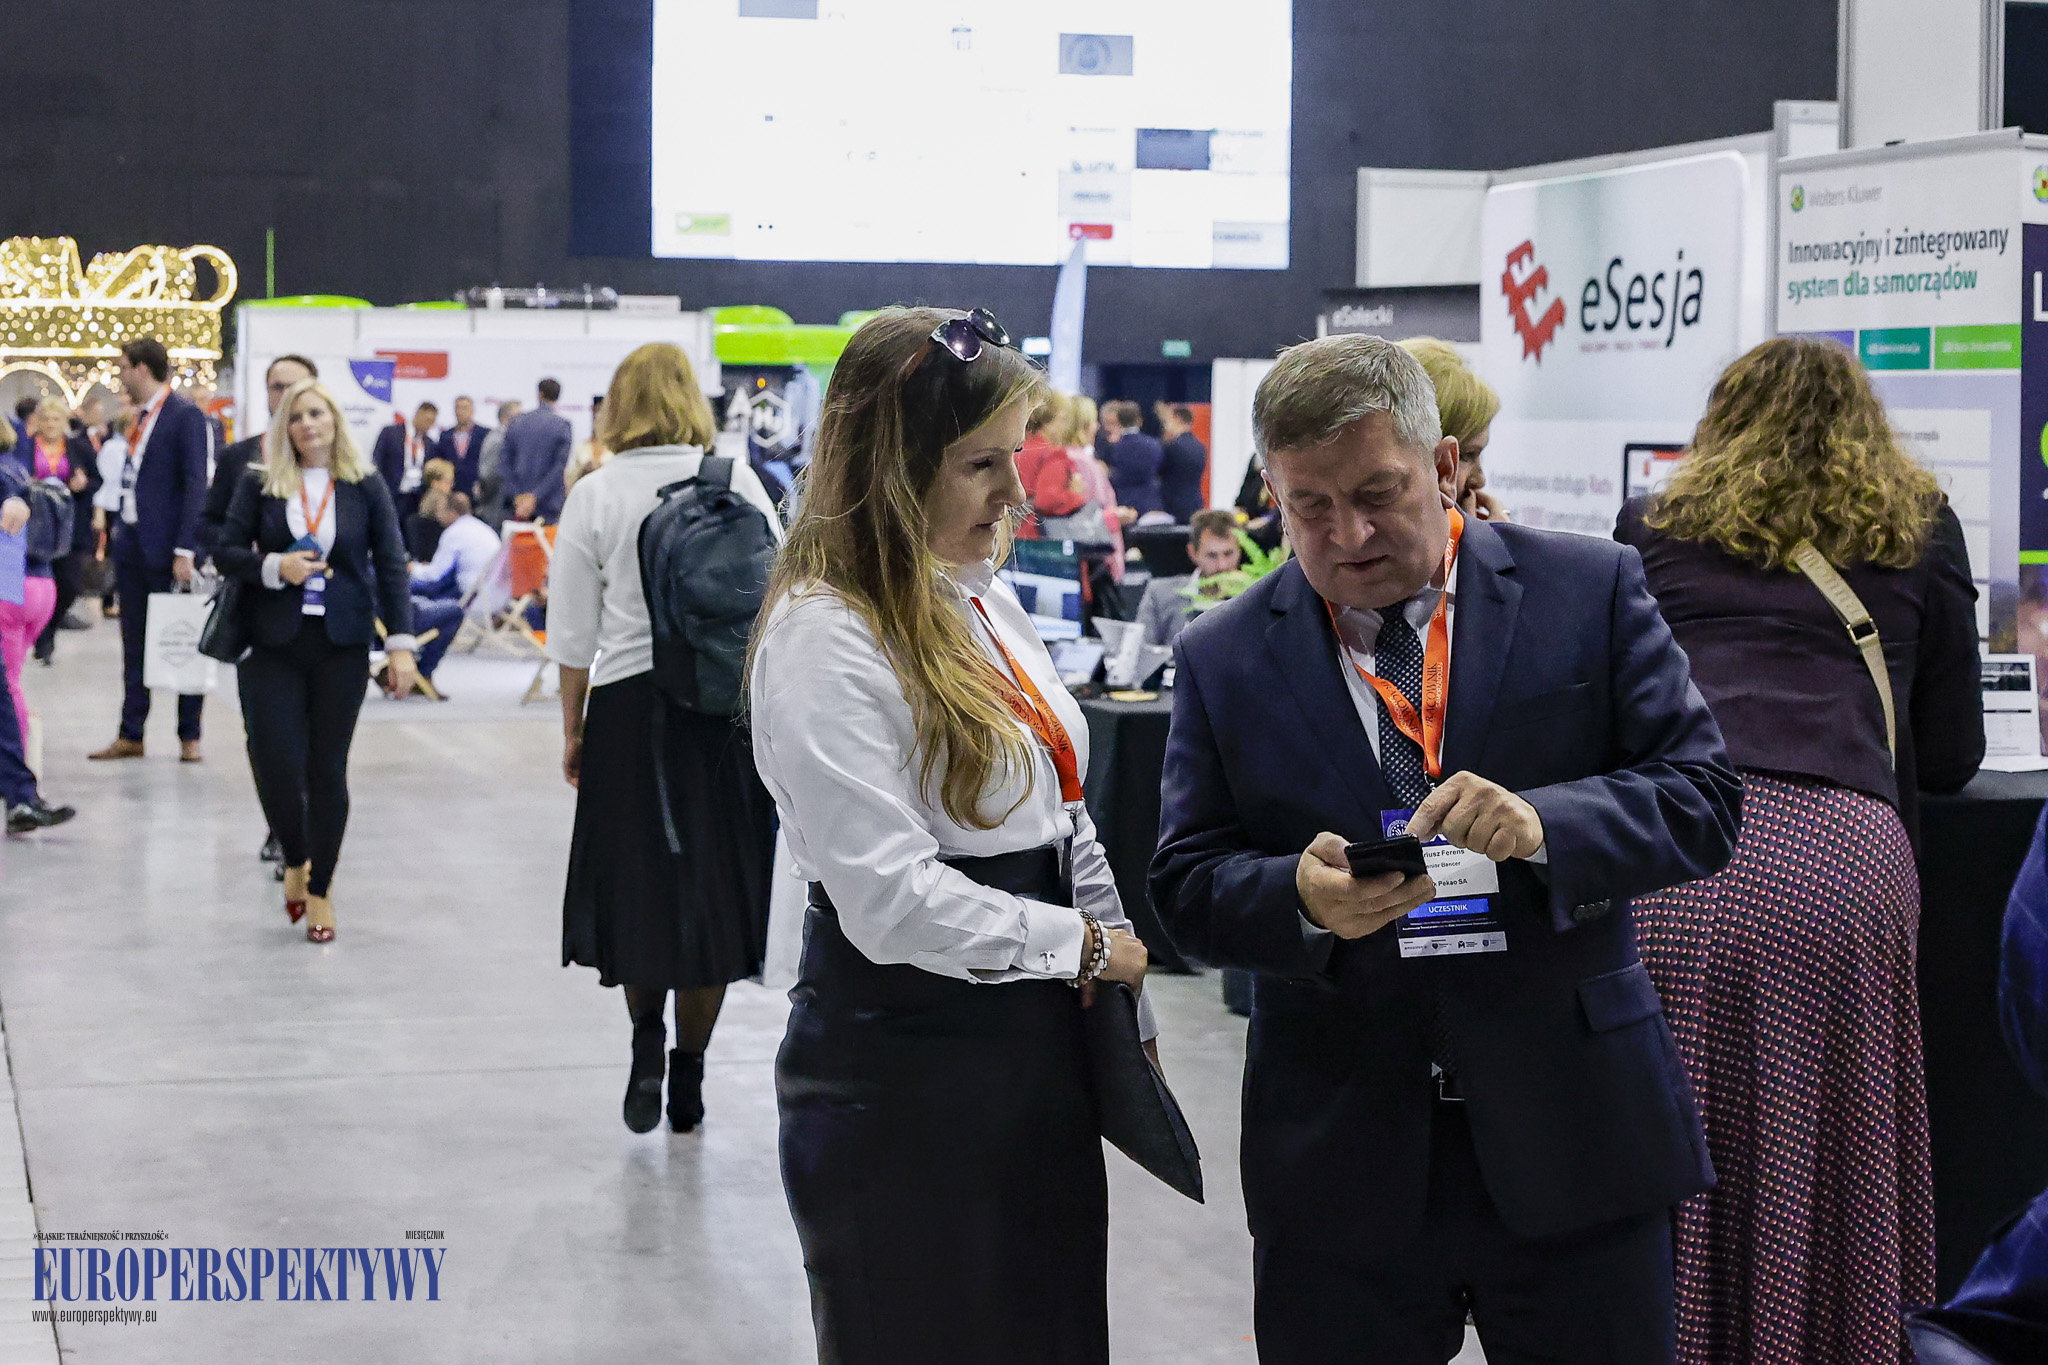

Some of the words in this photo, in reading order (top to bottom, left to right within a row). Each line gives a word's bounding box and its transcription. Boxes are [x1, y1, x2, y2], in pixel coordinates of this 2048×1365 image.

[1788, 230, 1883, 266] Innowacyjny
[1886, 228, 1892, 256] i
[1895, 226, 2009, 260] zintegrowany
[1580, 248, 1705, 348] eSesja
[1788, 276, 1839, 305] system
[1844, 270, 1870, 296] dla
[1873, 262, 1978, 300] samorządów
[1423, 850, 1440, 858] riusz
[1428, 904, 1468, 913] UCZESTNIK
